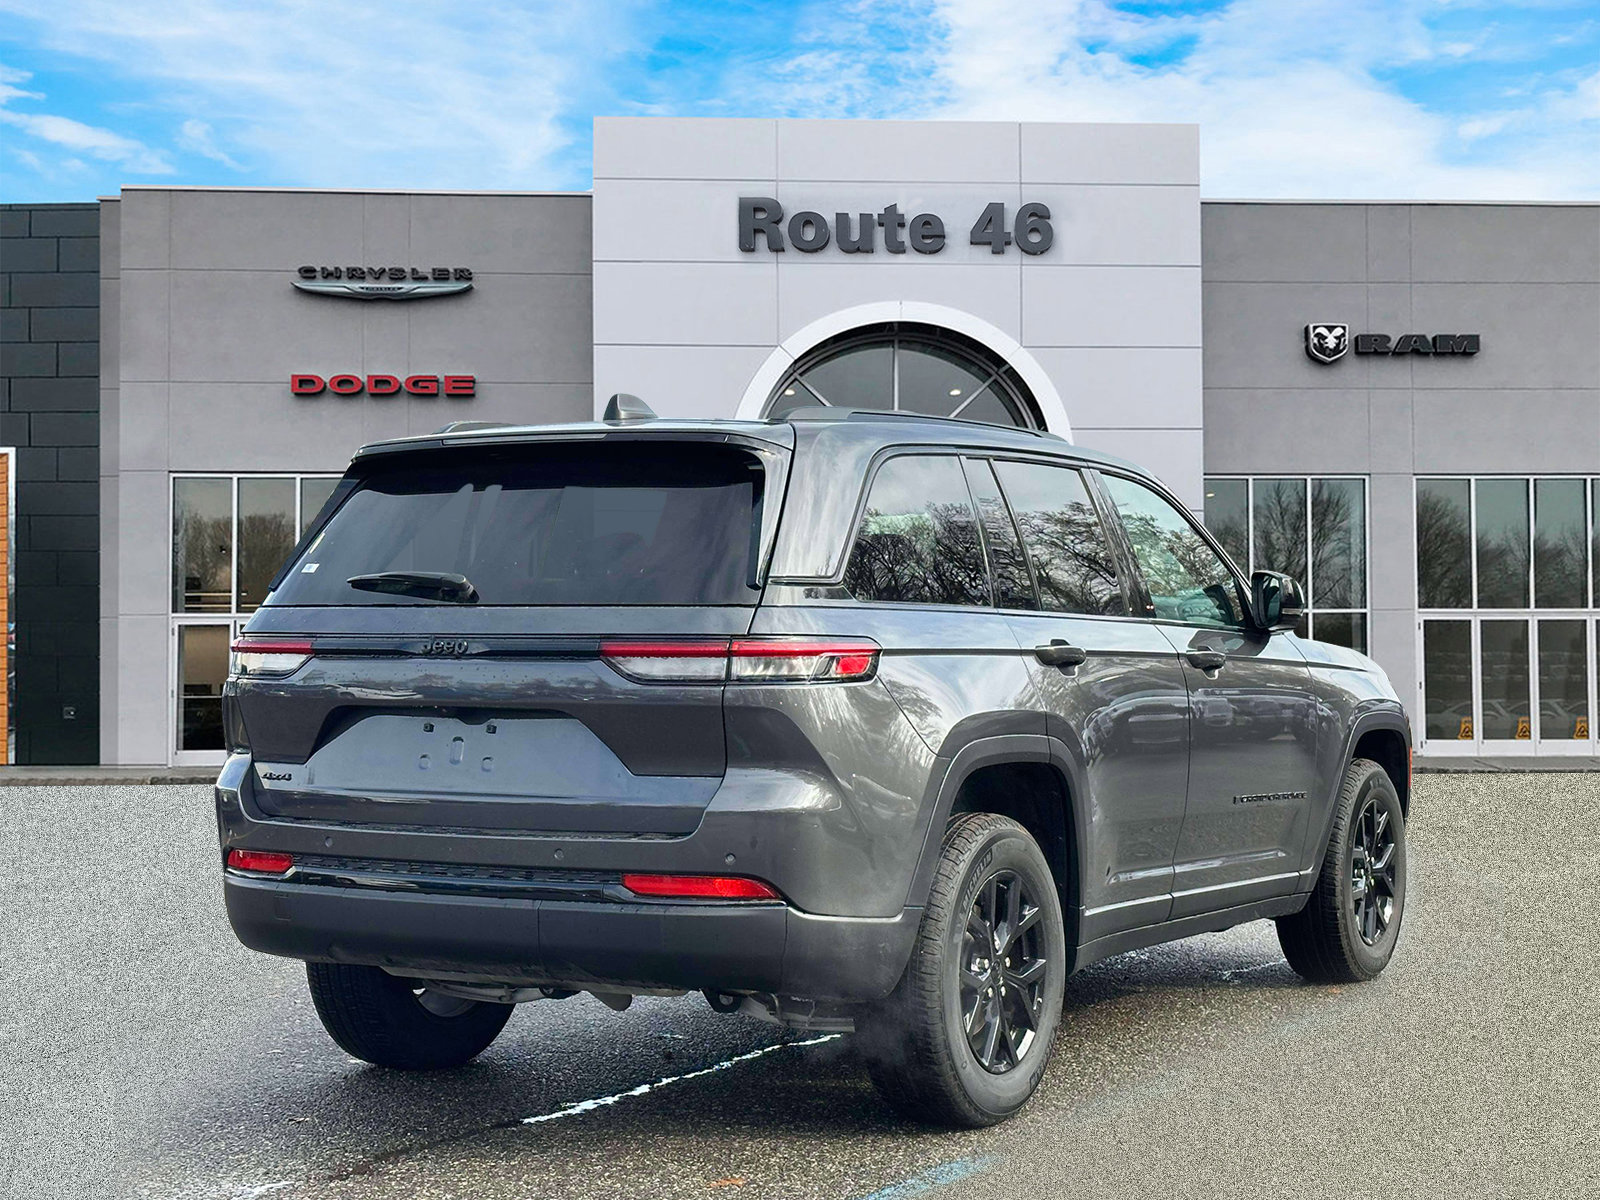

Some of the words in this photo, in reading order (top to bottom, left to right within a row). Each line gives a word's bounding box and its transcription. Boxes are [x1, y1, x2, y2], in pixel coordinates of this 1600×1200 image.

[738, 197, 946, 254] Route
[969, 202, 1054, 255] 46
[297, 266, 473, 280] CHRYSLER
[1355, 334, 1480, 355] RAM
[291, 374, 476, 397] DODGE
[421, 636, 469, 655] Jeep
